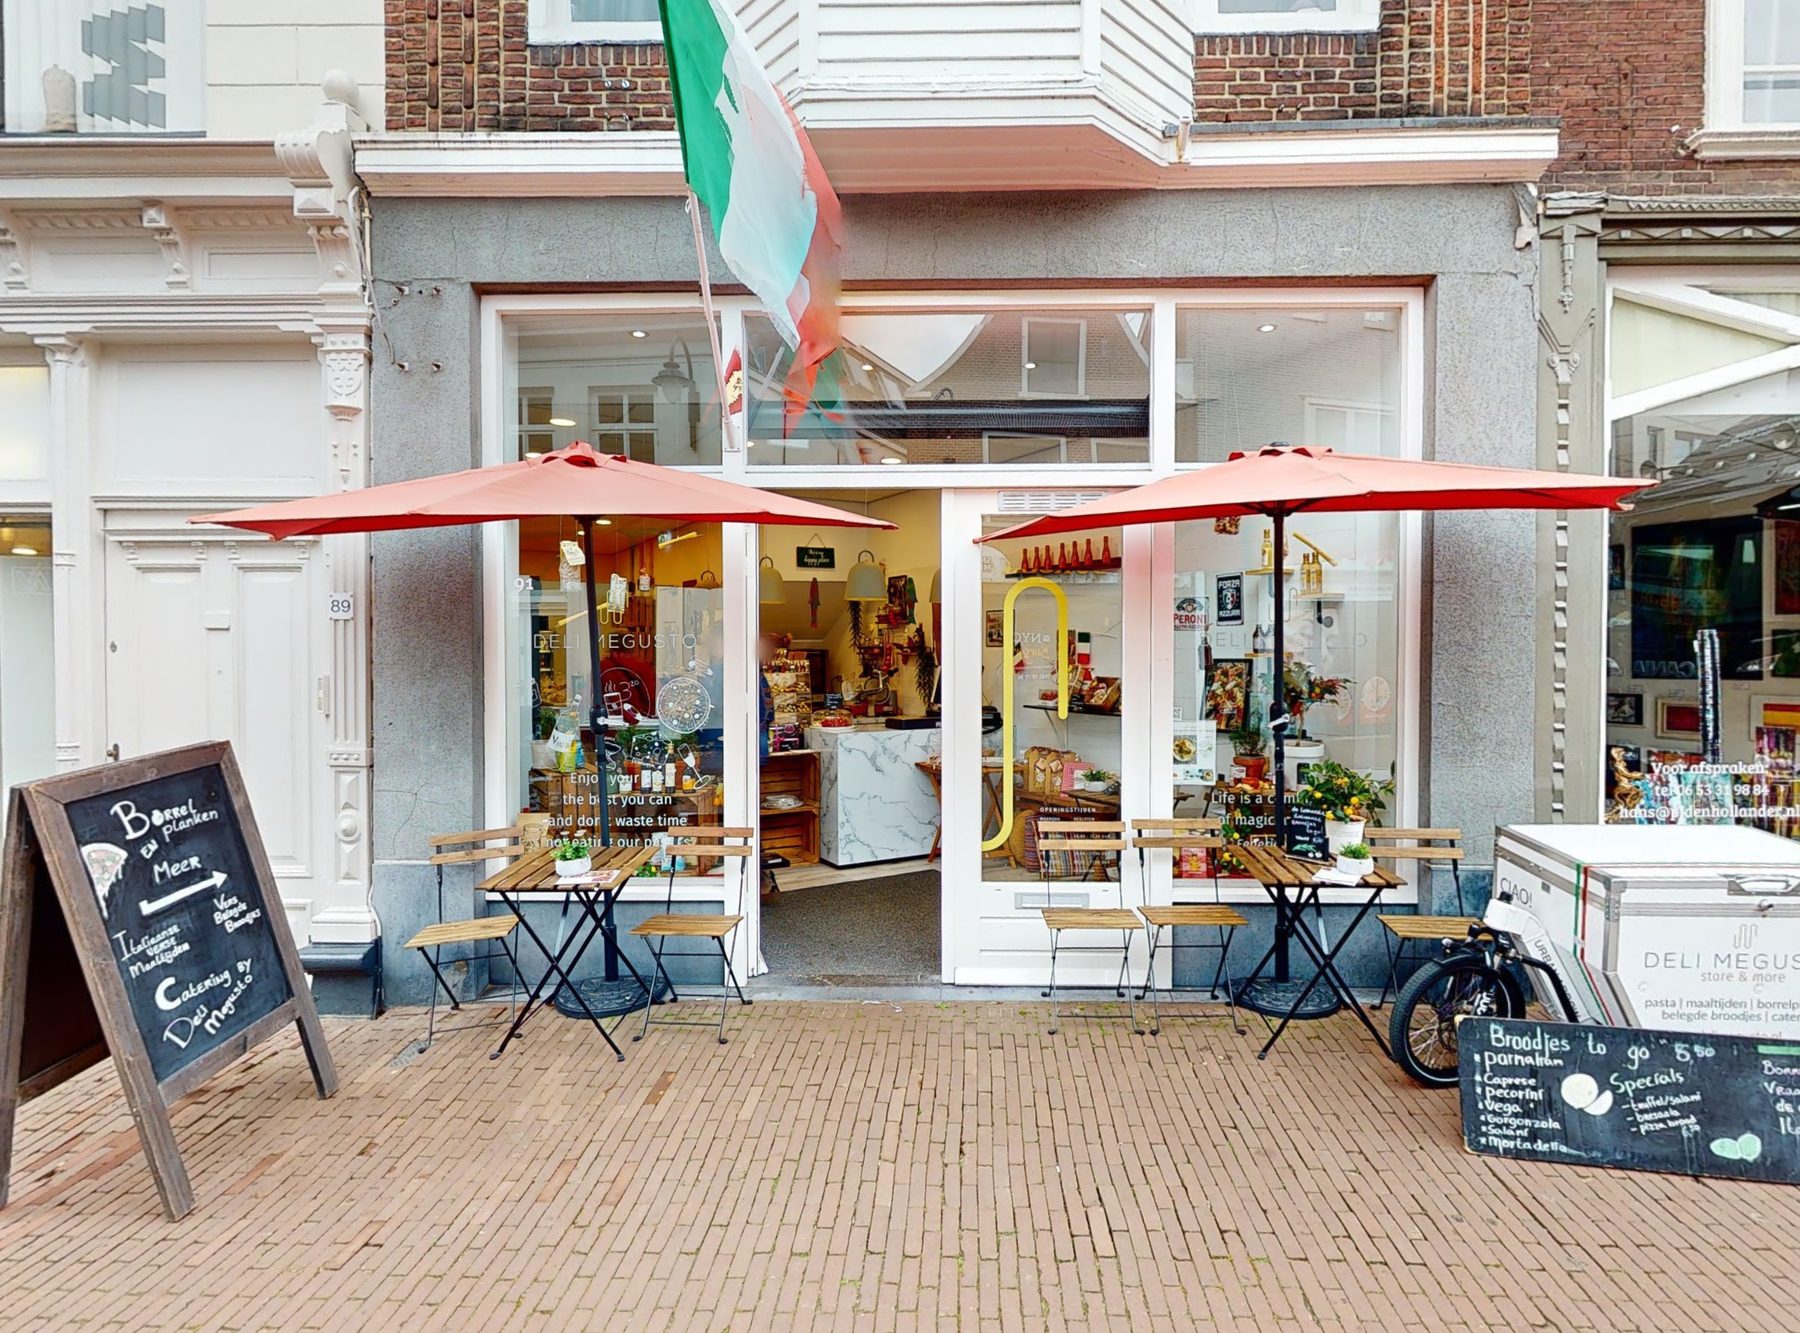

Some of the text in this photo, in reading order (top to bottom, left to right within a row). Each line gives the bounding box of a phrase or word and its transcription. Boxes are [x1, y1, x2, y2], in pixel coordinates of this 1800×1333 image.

[513, 578, 534, 592] 91
[1219, 580, 1240, 589] FORZA
[331, 600, 350, 613] 89
[1173, 613, 1206, 624] PERONI
[533, 634, 580, 649] DELI
[570, 773, 599, 787] Enjo
[610, 774, 640, 787] your
[1211, 791, 1236, 804] Life
[1240, 791, 1251, 804] is
[1255, 794, 1263, 804] a
[1696, 785, 1712, 796] 53
[1734, 785, 1750, 796] 98
[1753, 785, 1770, 796] 84
[563, 793, 584, 805] the
[621, 796, 645, 808] you
[649, 796, 672, 805] can
[163, 810, 218, 842] planken
[549, 815, 573, 827] and
[615, 816, 655, 827] waste
[658, 815, 687, 827] time
[1235, 813, 1276, 828] magic
[140, 840, 159, 860] EN
[617, 839, 638, 848] our
[1501, 877, 1532, 908] CIAO!
[1644, 952, 1700, 969] DELI
[1701, 971, 1786, 983] store & more
[1645, 1000, 1677, 1010] pasta
[1686, 998, 1748, 1011] maaltijden
[1662, 1010, 1708, 1022] belegde
[1711, 1010, 1762, 1023] broodjes
[163, 1004, 208, 1049] Deli
[1490, 1023, 1571, 1058] Broodjes
[1484, 1072, 1537, 1089] Caprese
[1610, 1068, 1685, 1097] Specials
[1484, 1100, 1523, 1116] Vega
[1487, 1113, 1562, 1130] Gorgonzola
